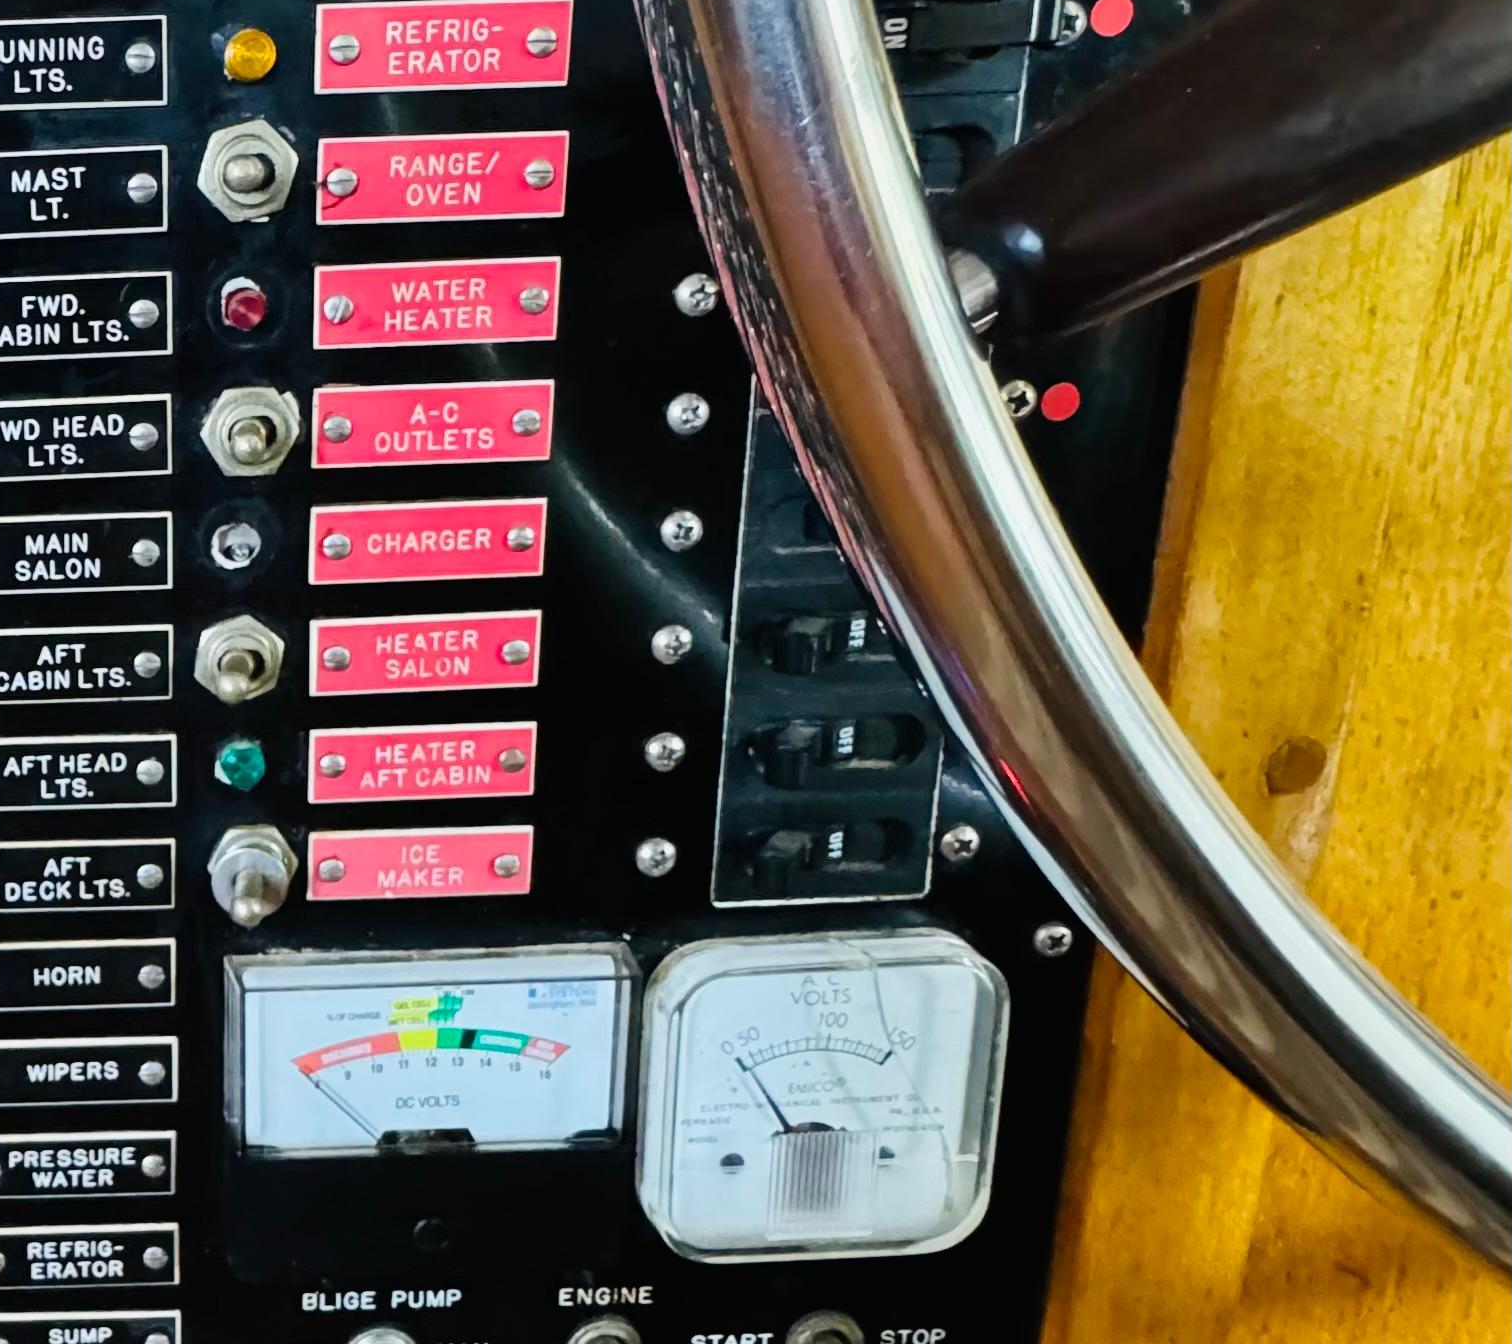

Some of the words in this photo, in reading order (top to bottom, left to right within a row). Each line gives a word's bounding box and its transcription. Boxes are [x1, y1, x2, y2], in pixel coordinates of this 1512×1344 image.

[384, 19, 505, 46] REFRIG-
[883, 16, 910, 50] ON
[386, 47, 502, 77] ERATOR
[12, 67, 74, 94] LTS.
[388, 151, 501, 179] RANGE/
[9, 166, 87, 194] MAST
[404, 179, 482, 208] OVEN
[29, 195, 70, 222] LT.
[390, 278, 488, 303] WATER
[20, 292, 86, 319] FWD.
[382, 304, 494, 332] HEATER
[71, 318, 131, 344] LTS.
[51, 412, 126, 441] HEAD
[409, 402, 460, 426] A-C
[373, 428, 496, 454] OUTLETS
[26, 441, 86, 468] LTS.
[24, 532, 90, 556] MAIN
[366, 528, 493, 555] CHARGER
[13, 557, 102, 582] SALON
[375, 628, 479, 655] HEATER
[848, 617, 866, 652] OFF
[35, 643, 84, 666] AFT
[77, 665, 133, 689] LTS.
[384, 655, 472, 680] SALON
[374, 740, 477, 764] HEATER
[837, 726, 854, 755] OFF
[3, 753, 54, 777] AFT
[59, 752, 128, 775] HEAD
[359, 766, 408, 790] AFT
[413, 763, 492, 787] CABIN
[39, 776, 94, 800] LTS.
[399, 843, 441, 865] ICE
[828, 831, 845, 860] OFF
[43, 856, 92, 877] AFT
[376, 866, 464, 891] MAKER
[4, 878, 74, 902] DECK
[78, 876, 131, 899] LTS.
[32, 966, 102, 987] HORN
[790, 987, 852, 1006] VOLTS
[737, 1026, 761, 1047] 50
[818, 1012, 849, 1029] 100
[26, 1062, 120, 1083] WIPERS
[371, 1063, 384, 1074] 10
[398, 1059, 409, 1069] 11
[425, 1057, 437, 1067] 12
[452, 1058, 464, 1067] 13
[480, 1058, 492, 1067] 14
[509, 1062, 521, 1072] 15
[395, 1095, 415, 1109] DC
[417, 1094, 461, 1109] VOLTS
[8, 1147, 137, 1170] PRESSURE
[31, 1169, 115, 1189] WATER
[26, 1241, 124, 1260] REFRIG-
[30, 1260, 125, 1280] ERATOR
[301, 1290, 377, 1312] BLIGE
[390, 1289, 462, 1309] PUMP
[558, 1286, 654, 1307] ENGINE
